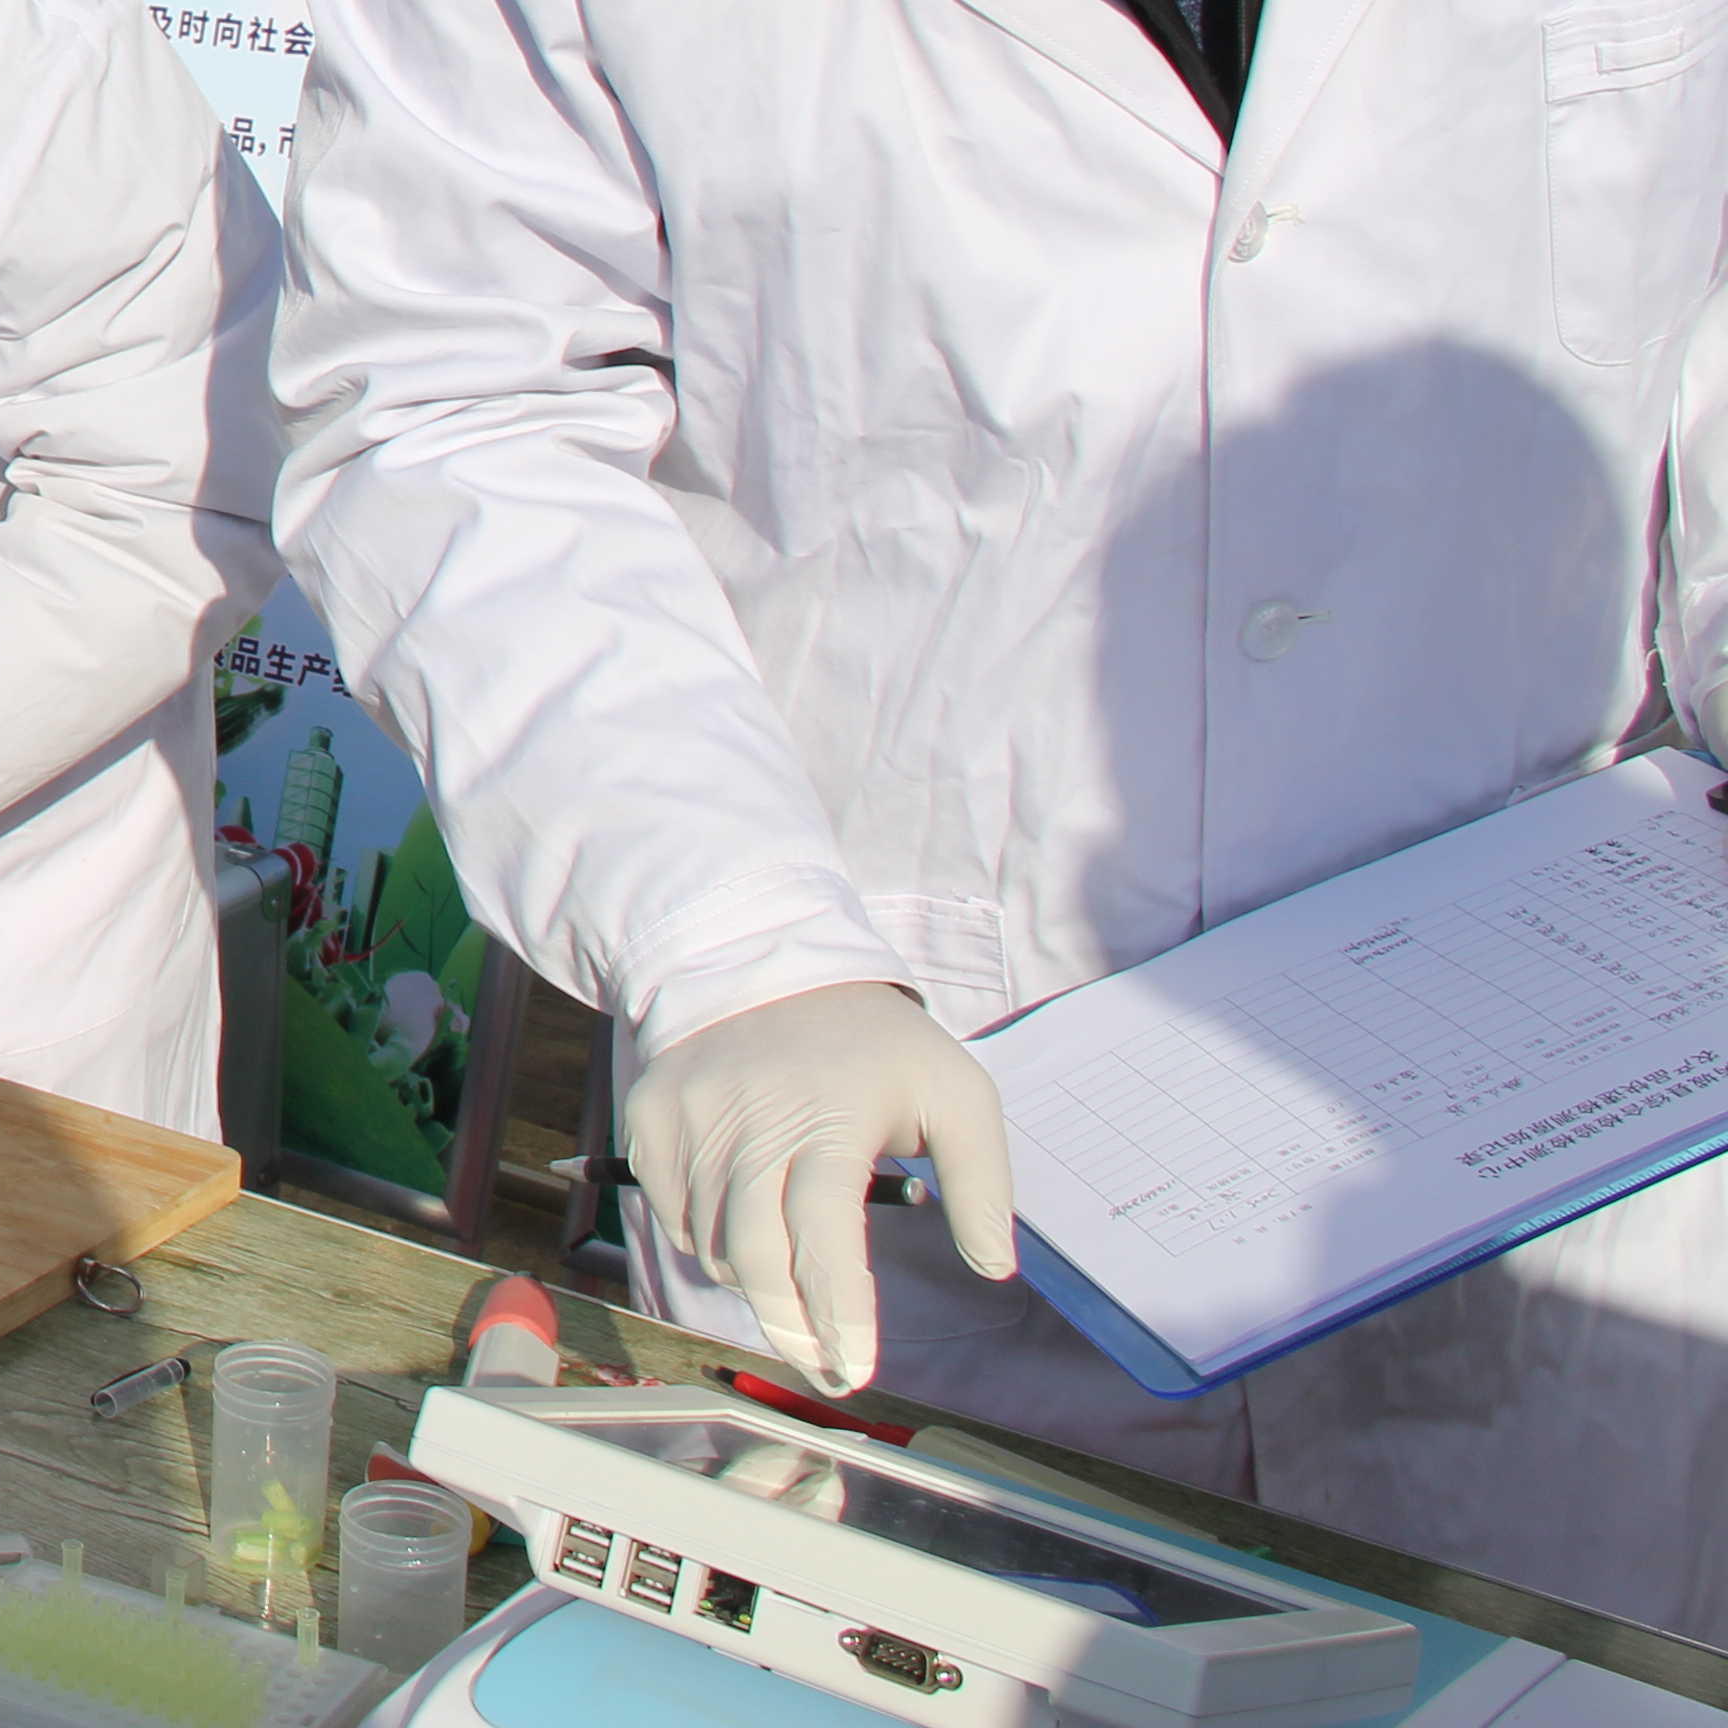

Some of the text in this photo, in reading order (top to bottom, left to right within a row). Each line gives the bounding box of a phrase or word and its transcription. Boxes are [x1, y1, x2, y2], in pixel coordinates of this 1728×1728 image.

[148, 5, 315, 57] 及时向社会
[1452, 1046, 1722, 1169] 农产品快速检测原始记录
